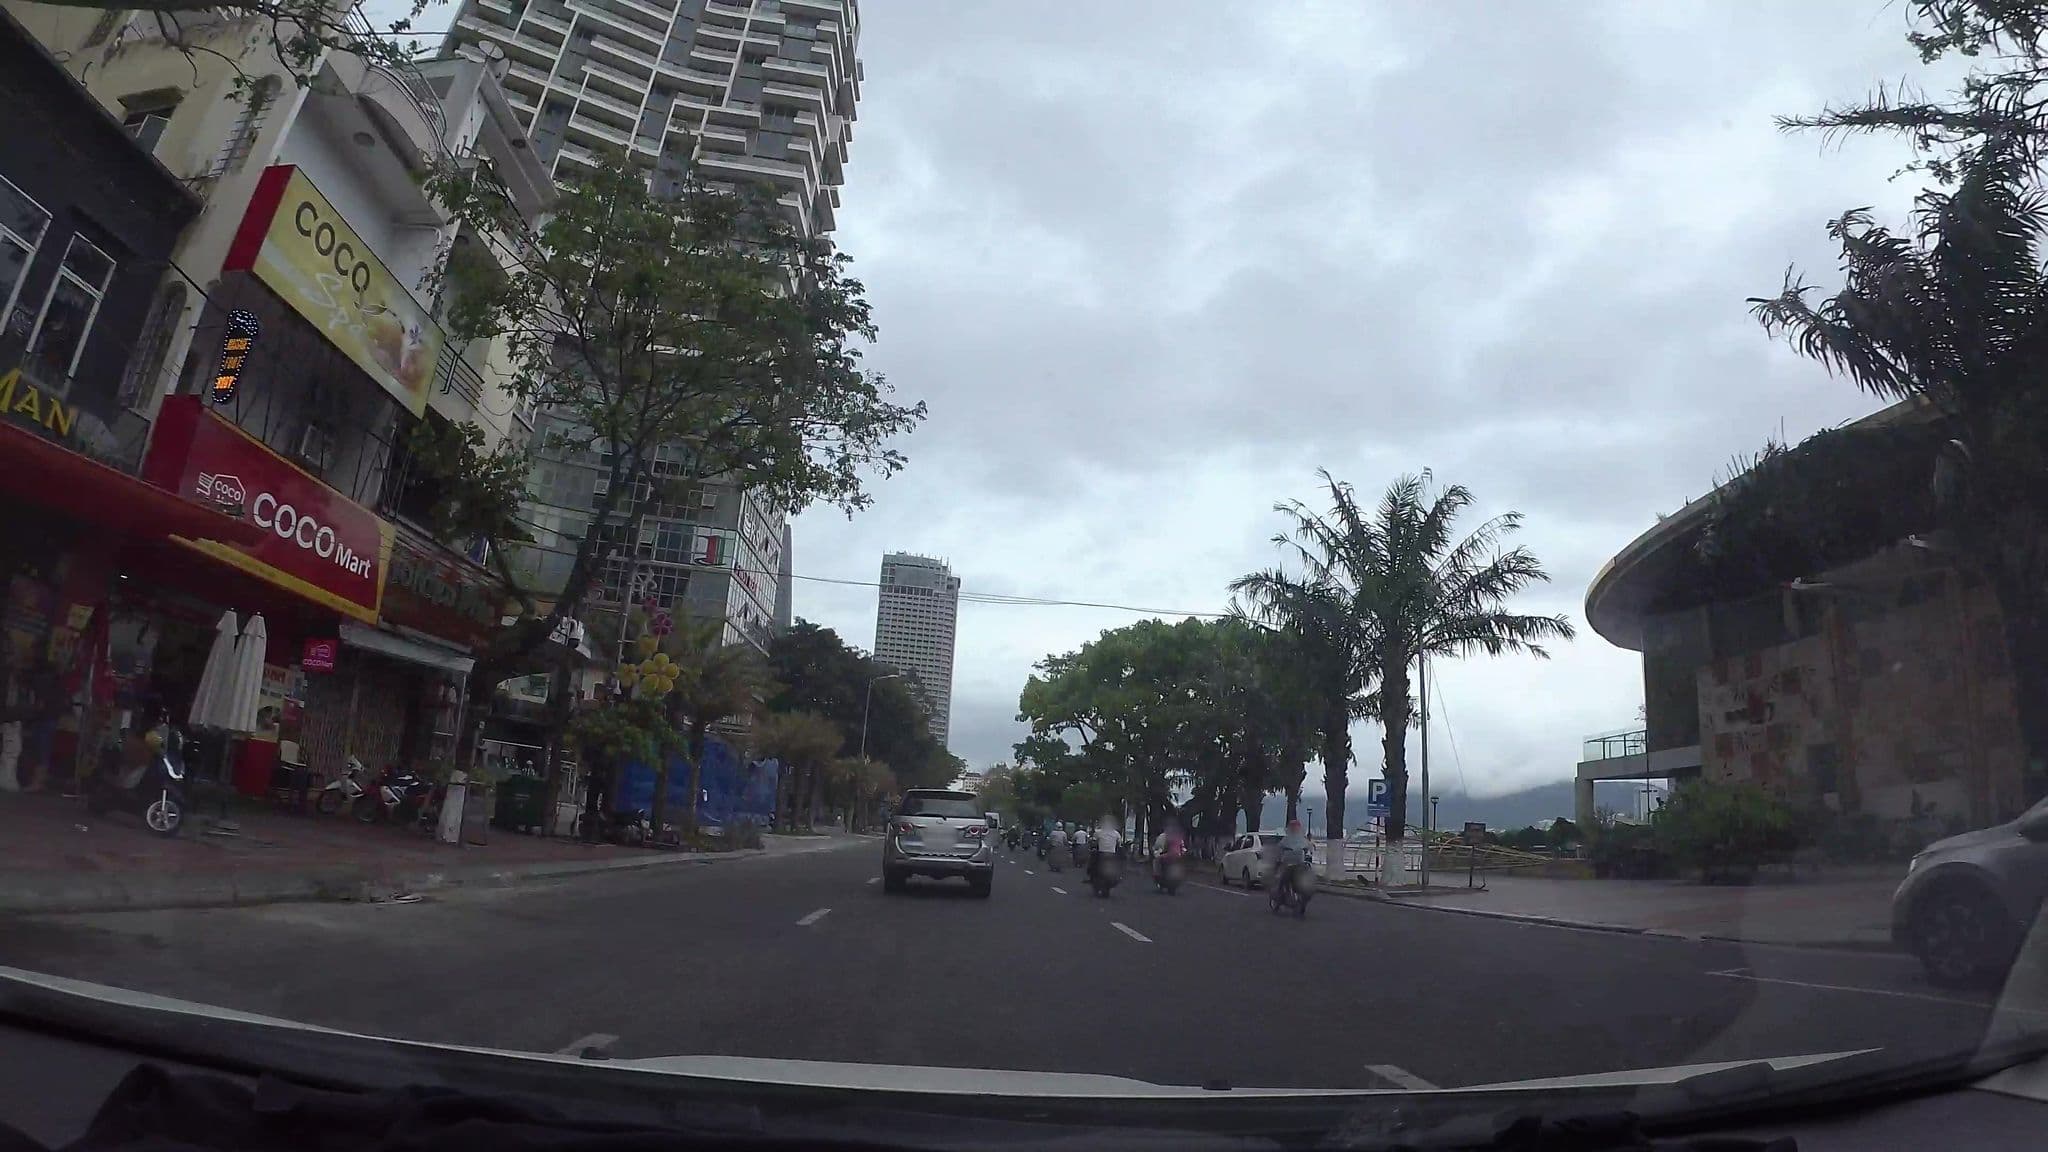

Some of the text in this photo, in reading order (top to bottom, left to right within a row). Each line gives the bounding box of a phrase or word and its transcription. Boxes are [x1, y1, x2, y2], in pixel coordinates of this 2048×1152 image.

[295, 201, 371, 293] COCO
[215, 481, 241, 501] COCO
[253, 492, 372, 579] COCO Mart
[1372, 781, 1388, 802] P
